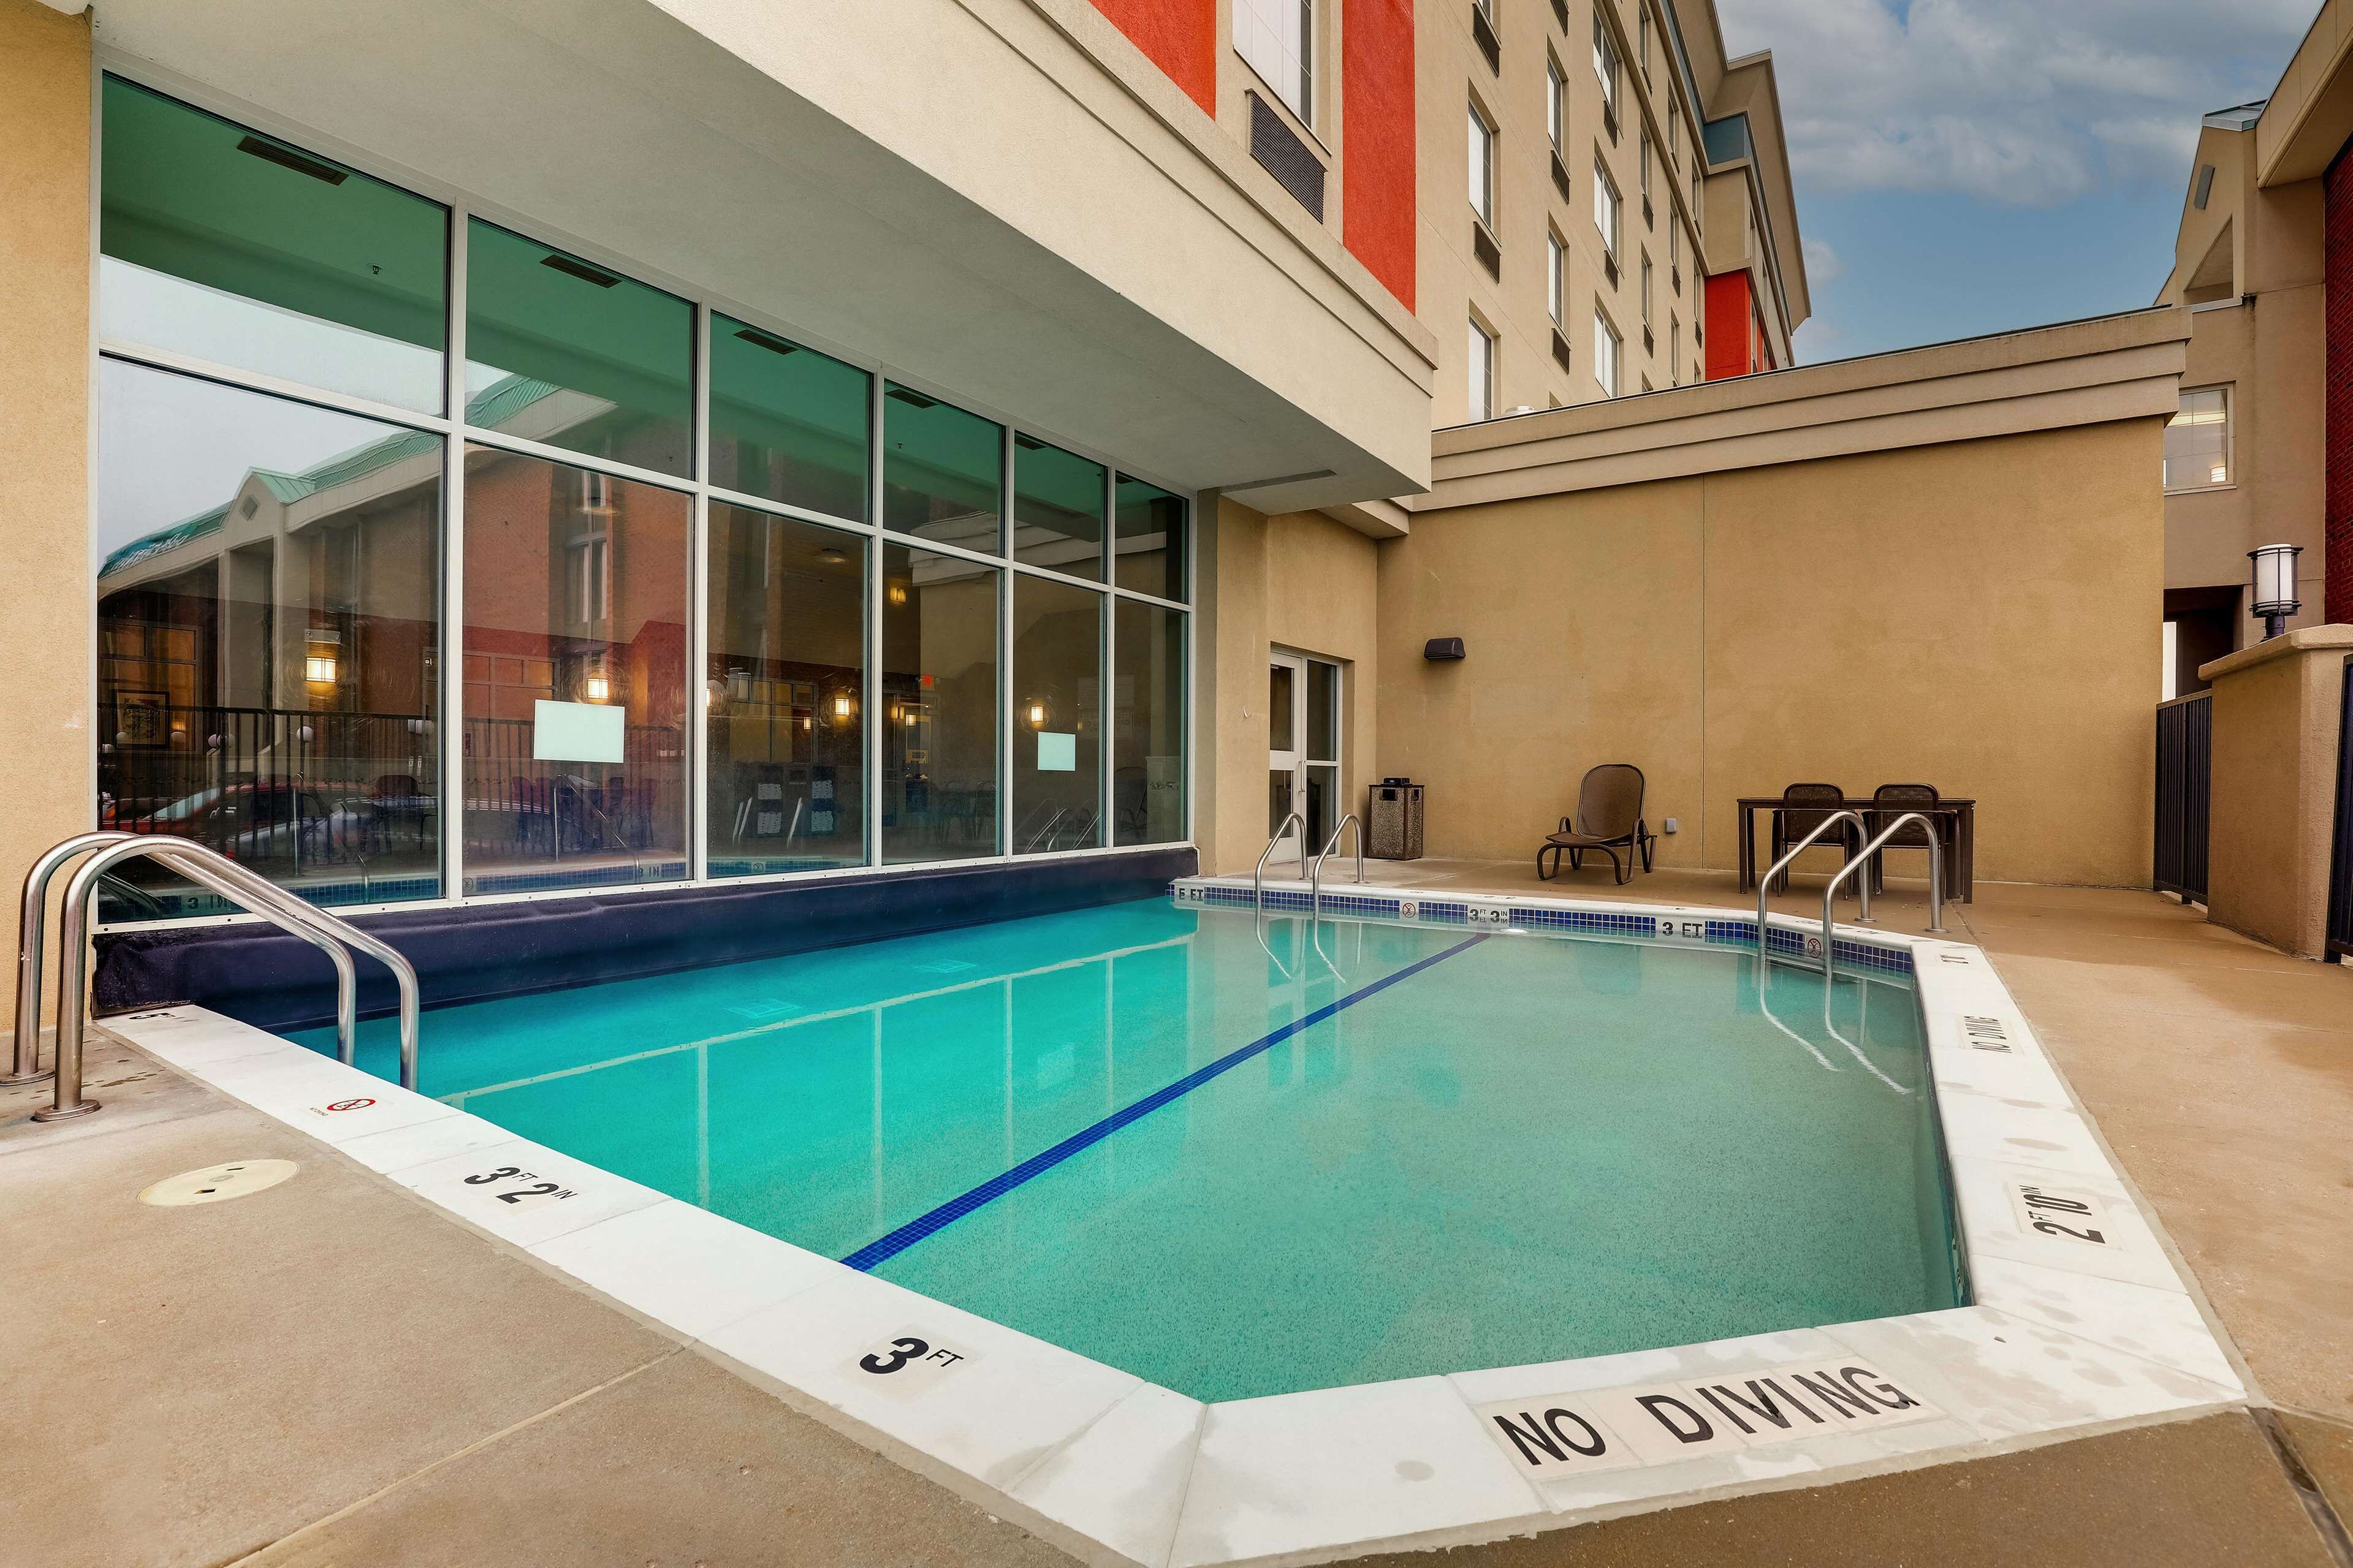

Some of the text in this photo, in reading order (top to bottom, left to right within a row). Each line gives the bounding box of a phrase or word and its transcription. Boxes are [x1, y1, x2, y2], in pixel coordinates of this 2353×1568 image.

[1470, 909, 1479, 922] 3
[1491, 910, 1500, 923] 3
[1662, 922, 1703, 936] 3 FT
[464, 1167, 578, 1205] 3 FT 2 IN
[2019, 1184, 2106, 1244] 2 FT 10 IN
[859, 1337, 965, 1374] 3 FT
[1492, 1366, 1921, 1466] NO DIVING
